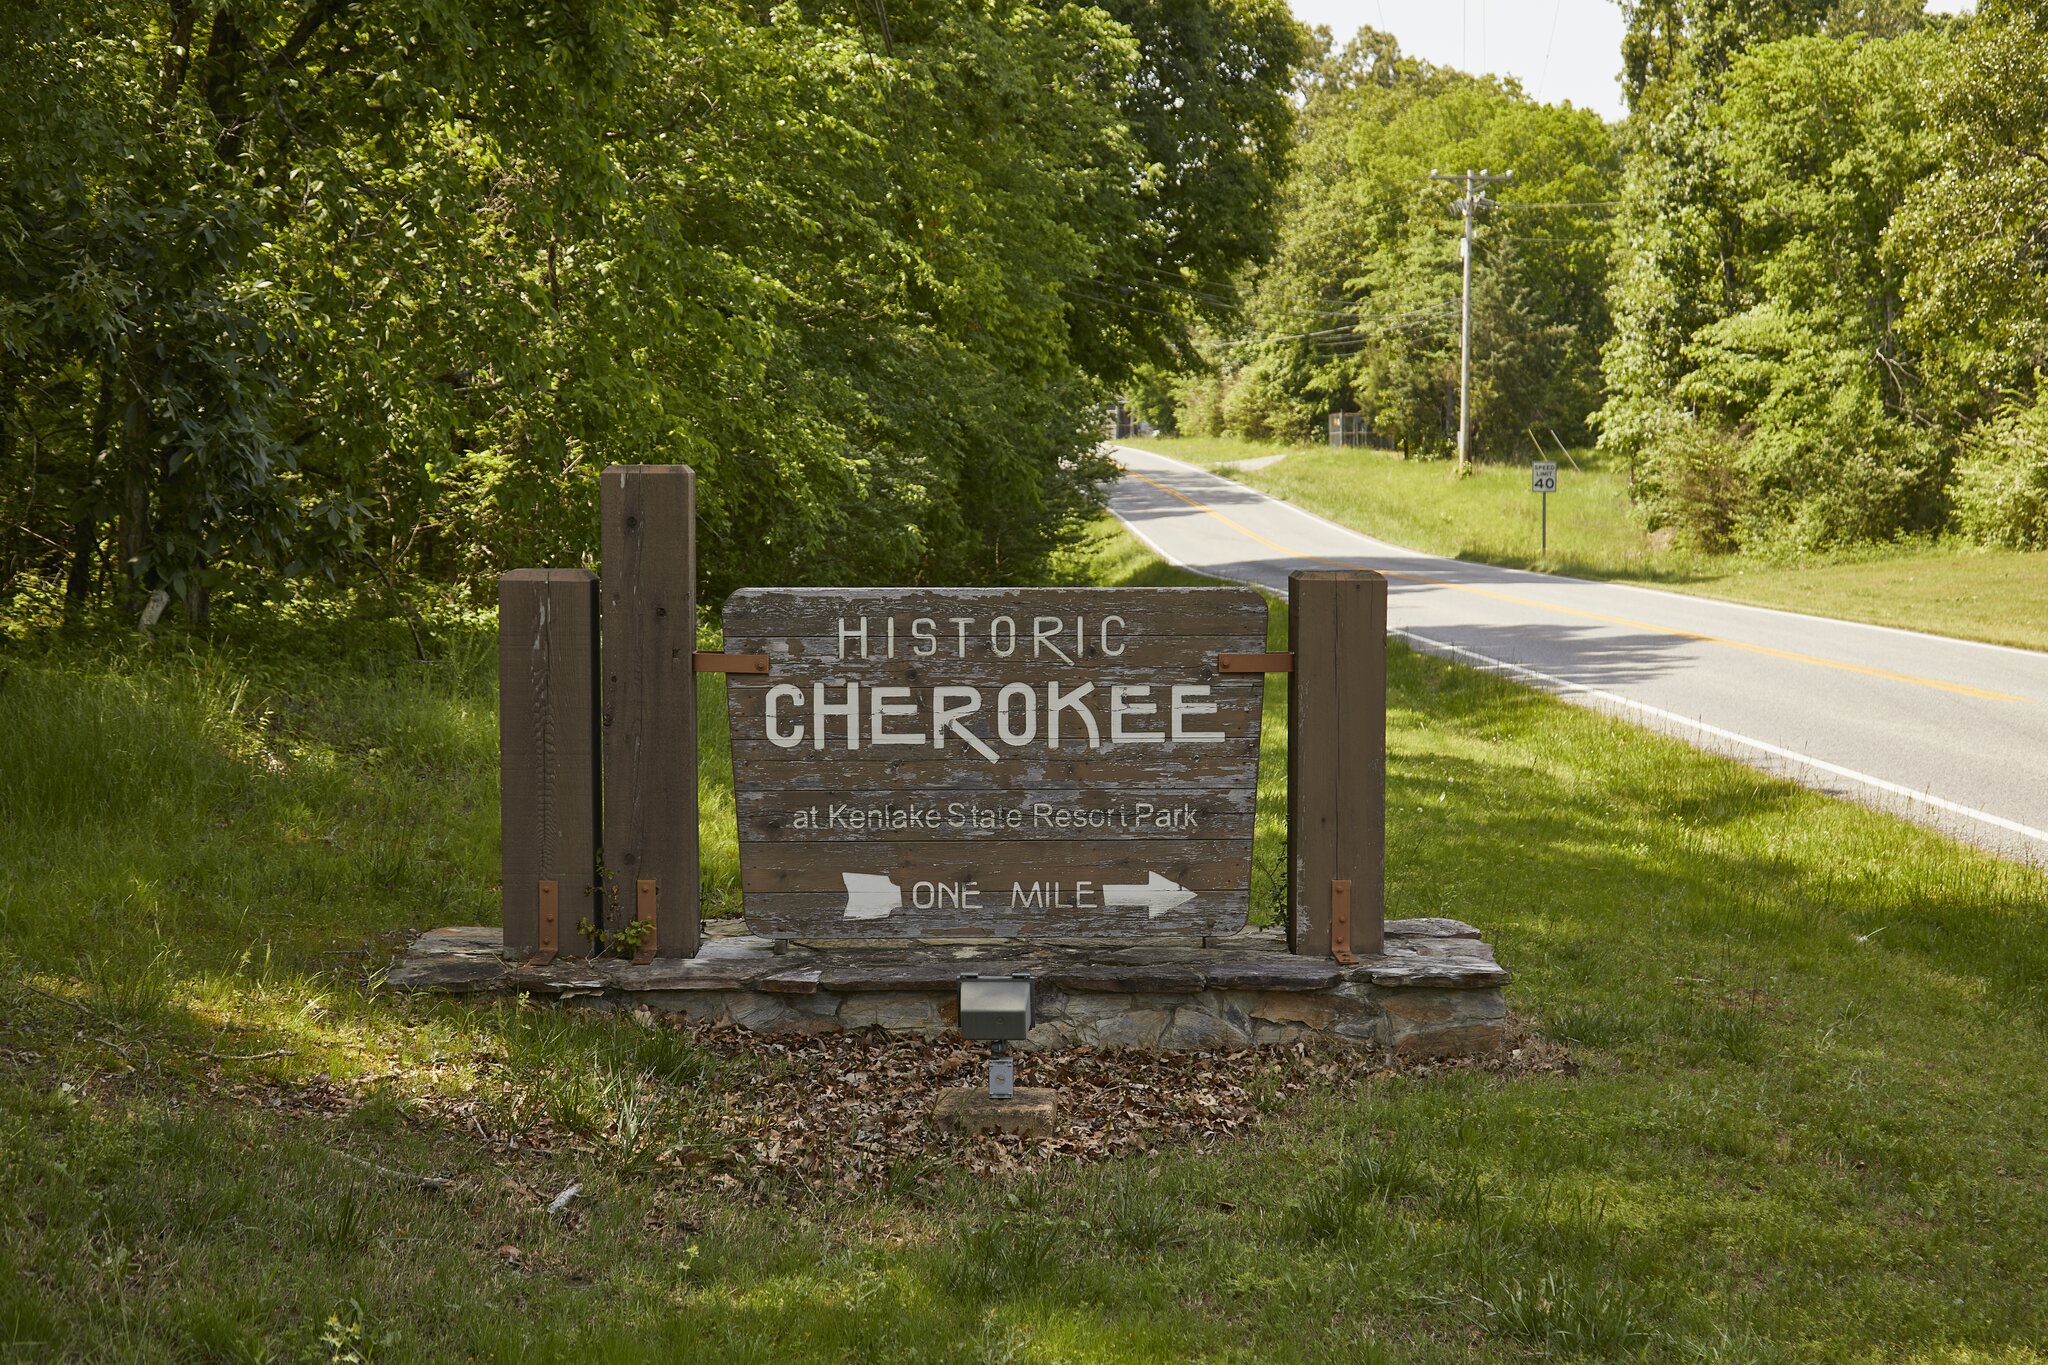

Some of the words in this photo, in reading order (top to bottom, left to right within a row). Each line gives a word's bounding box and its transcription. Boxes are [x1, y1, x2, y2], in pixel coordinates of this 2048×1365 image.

[1534, 478, 1554, 489] 40
[838, 615, 1126, 665] HISTORIC
[765, 681, 1226, 763] CHEROKEE
[793, 805, 819, 829] at
[828, 803, 942, 829] Kenlake
[947, 802, 1022, 828] State
[1033, 802, 1128, 828] Resort
[1135, 802, 1198, 828] Park
[912, 880, 983, 910] ONE
[1011, 881, 1098, 909] MILE
